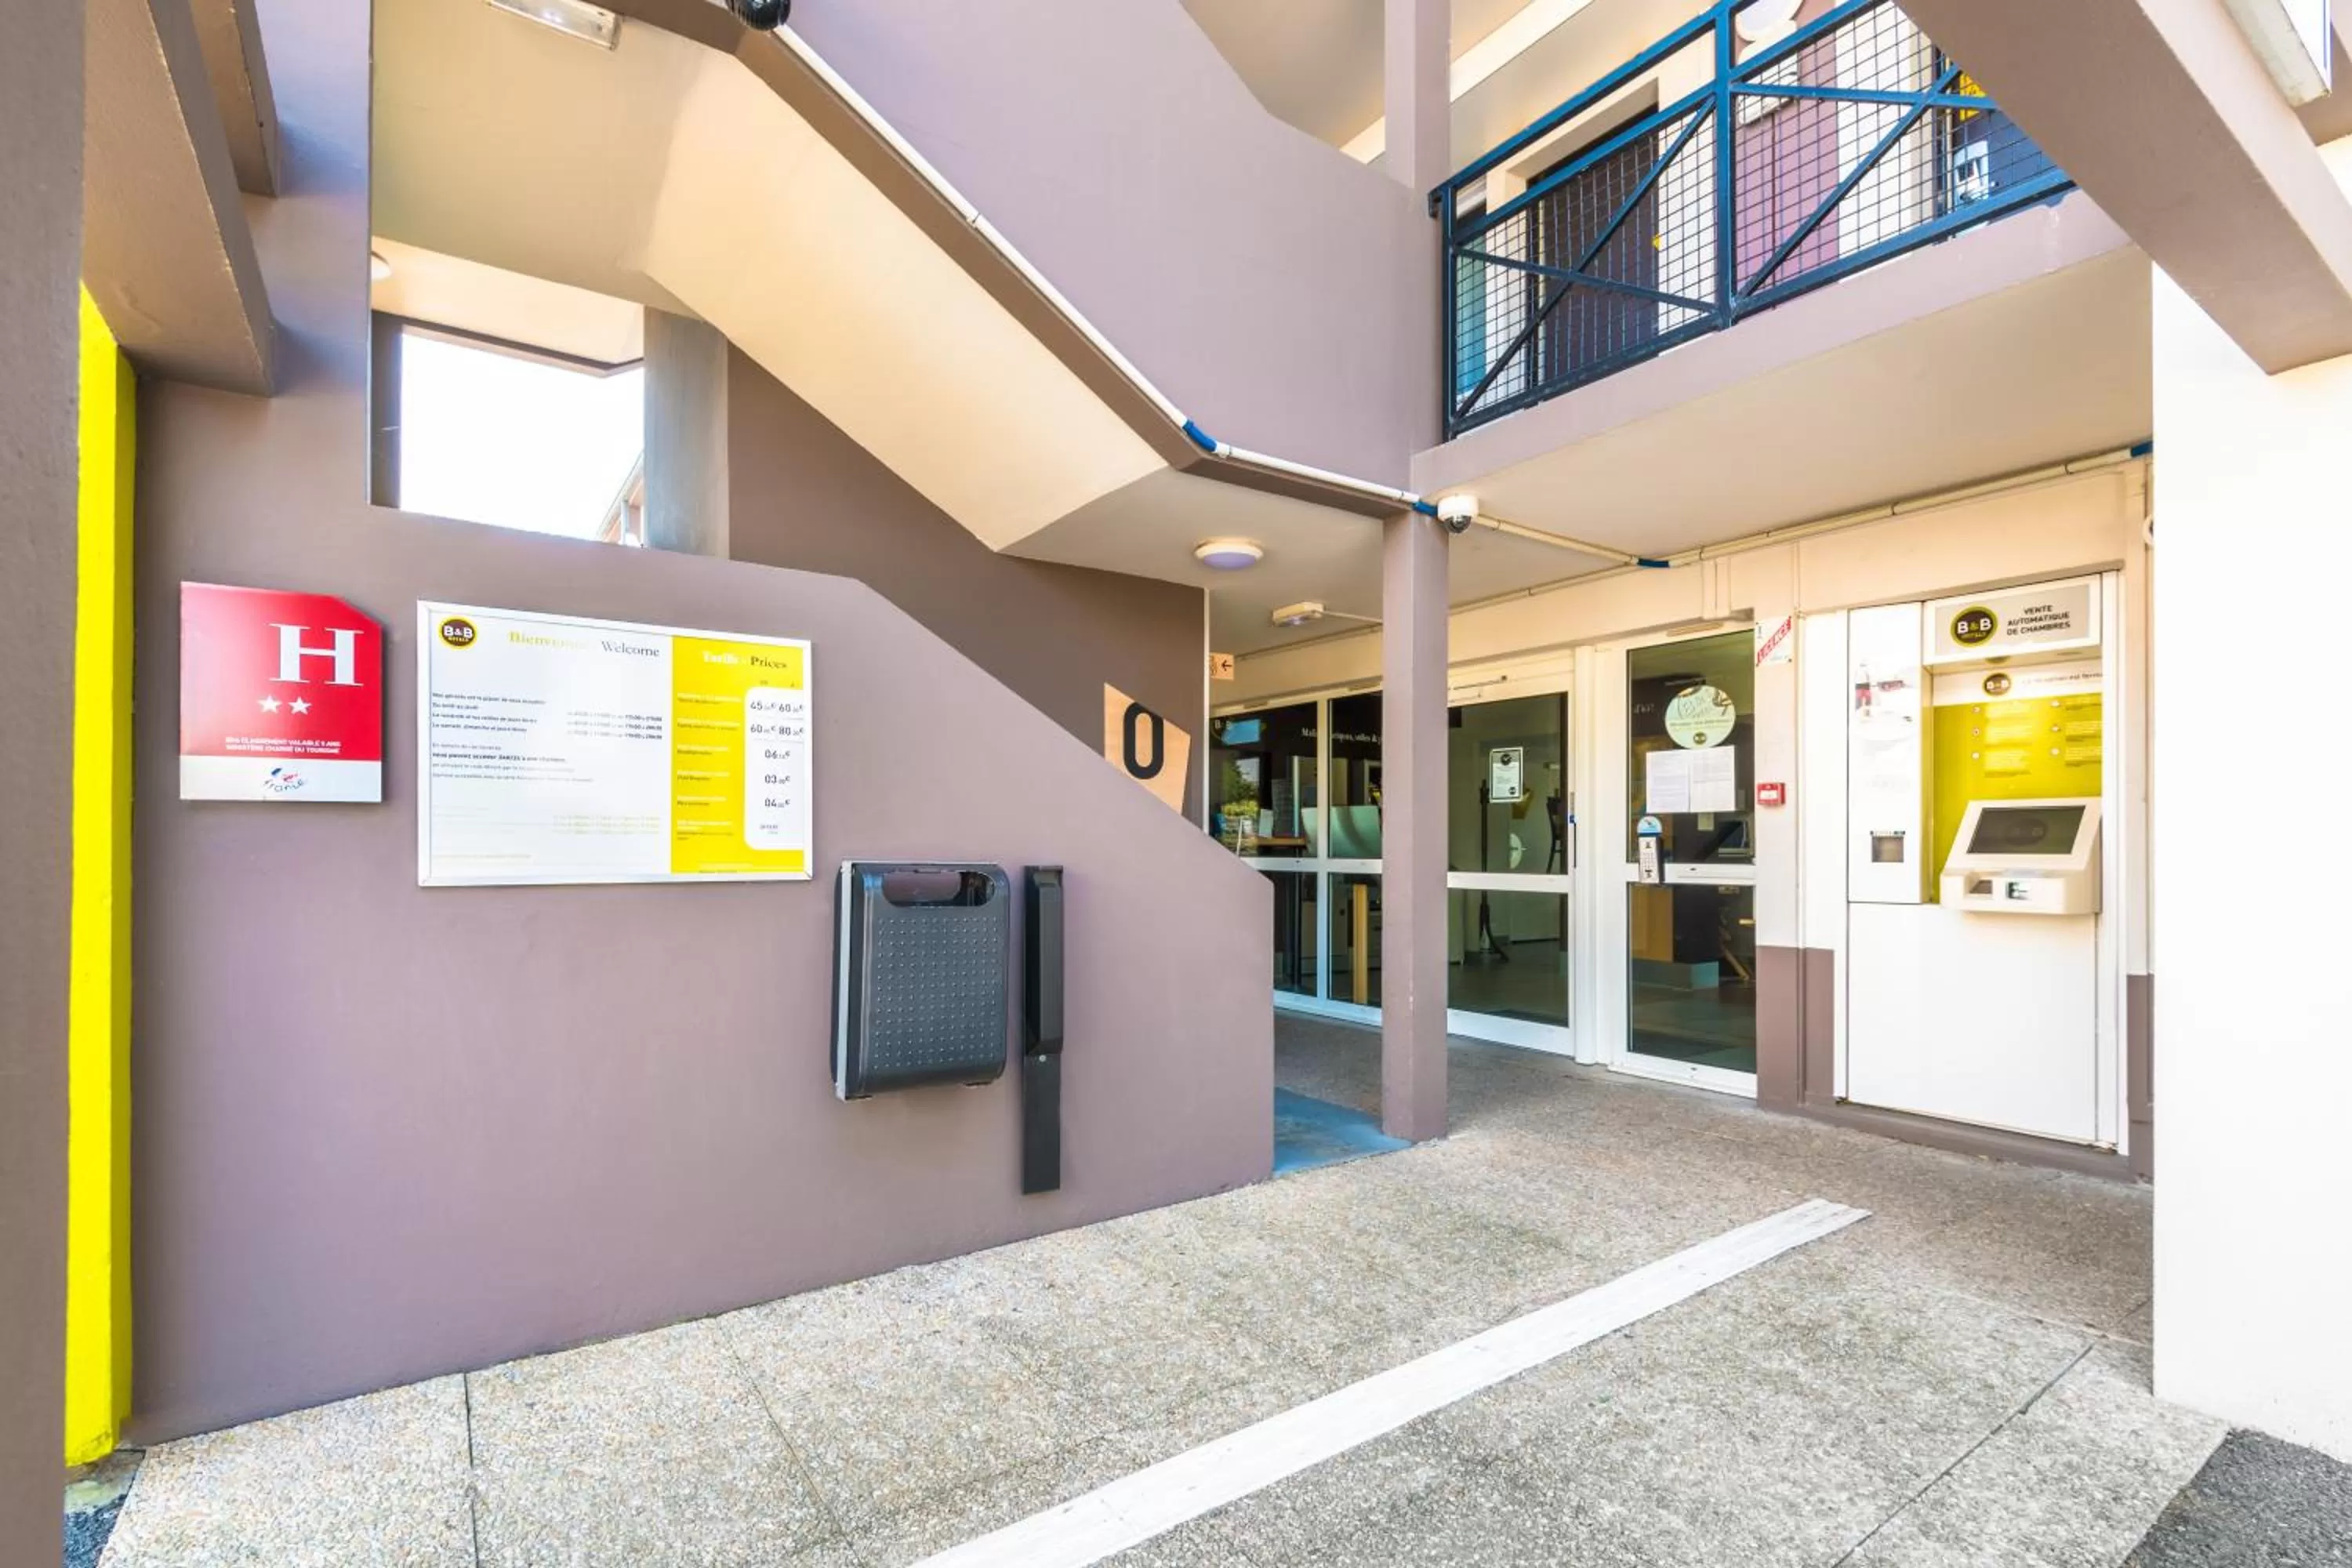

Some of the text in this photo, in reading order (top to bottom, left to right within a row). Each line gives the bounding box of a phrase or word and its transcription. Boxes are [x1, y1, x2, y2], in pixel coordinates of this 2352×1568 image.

[2024, 605, 2053, 615] VENTE
[2007, 612, 2070, 626] AUTOMATIQUE
[443, 625, 473, 638] B&B
[2020, 621, 2071, 634] CHAMBRES
[269, 622, 364, 687] H
[601, 640, 660, 657] Welcome
[750, 655, 787, 669] Prices
